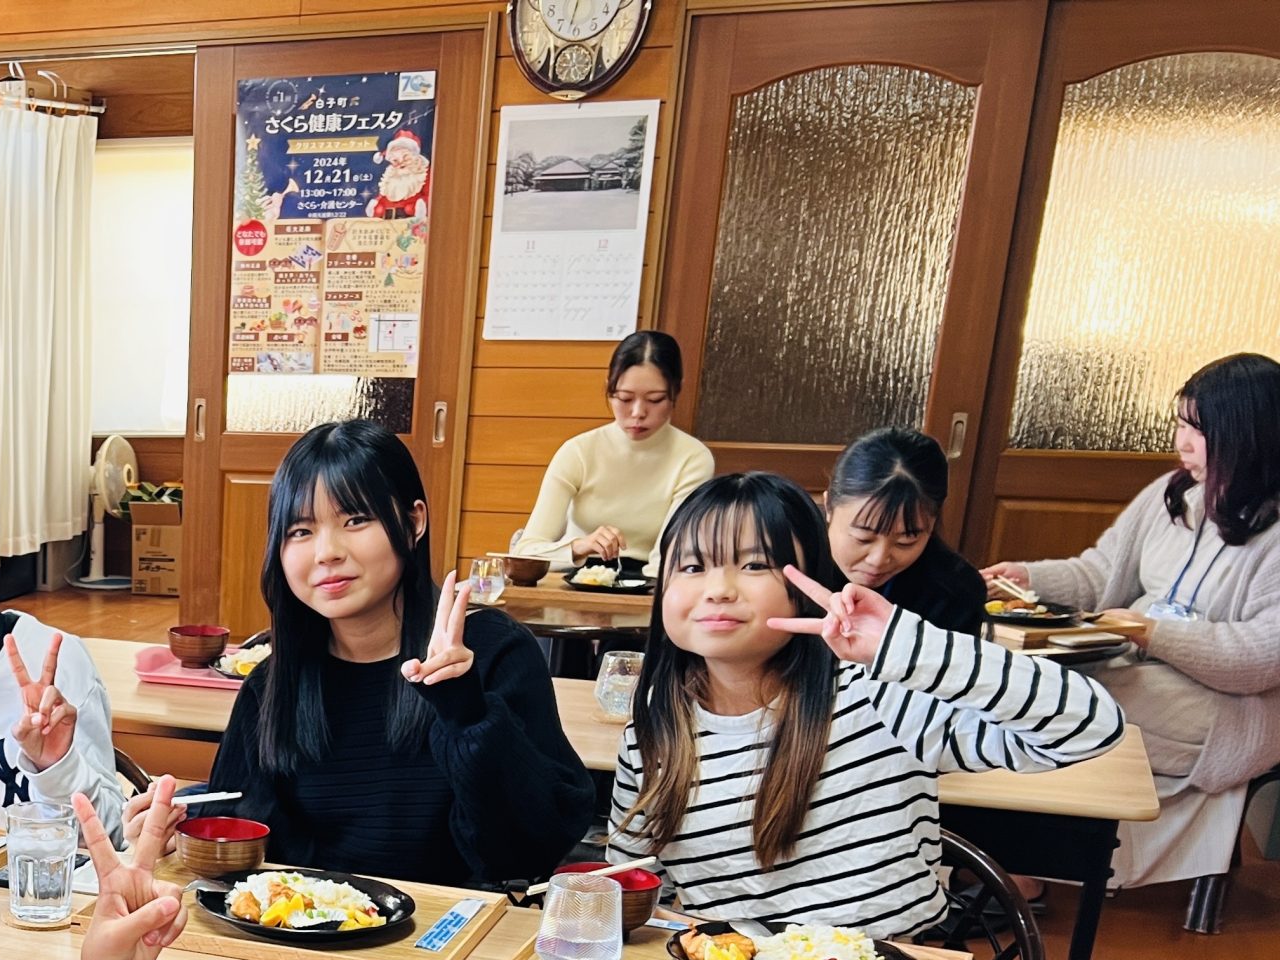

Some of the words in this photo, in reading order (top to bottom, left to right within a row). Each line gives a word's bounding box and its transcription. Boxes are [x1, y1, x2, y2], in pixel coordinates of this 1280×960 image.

[265, 111, 404, 134] さくら健康フェスタ
[313, 157, 348, 168] 2024年
